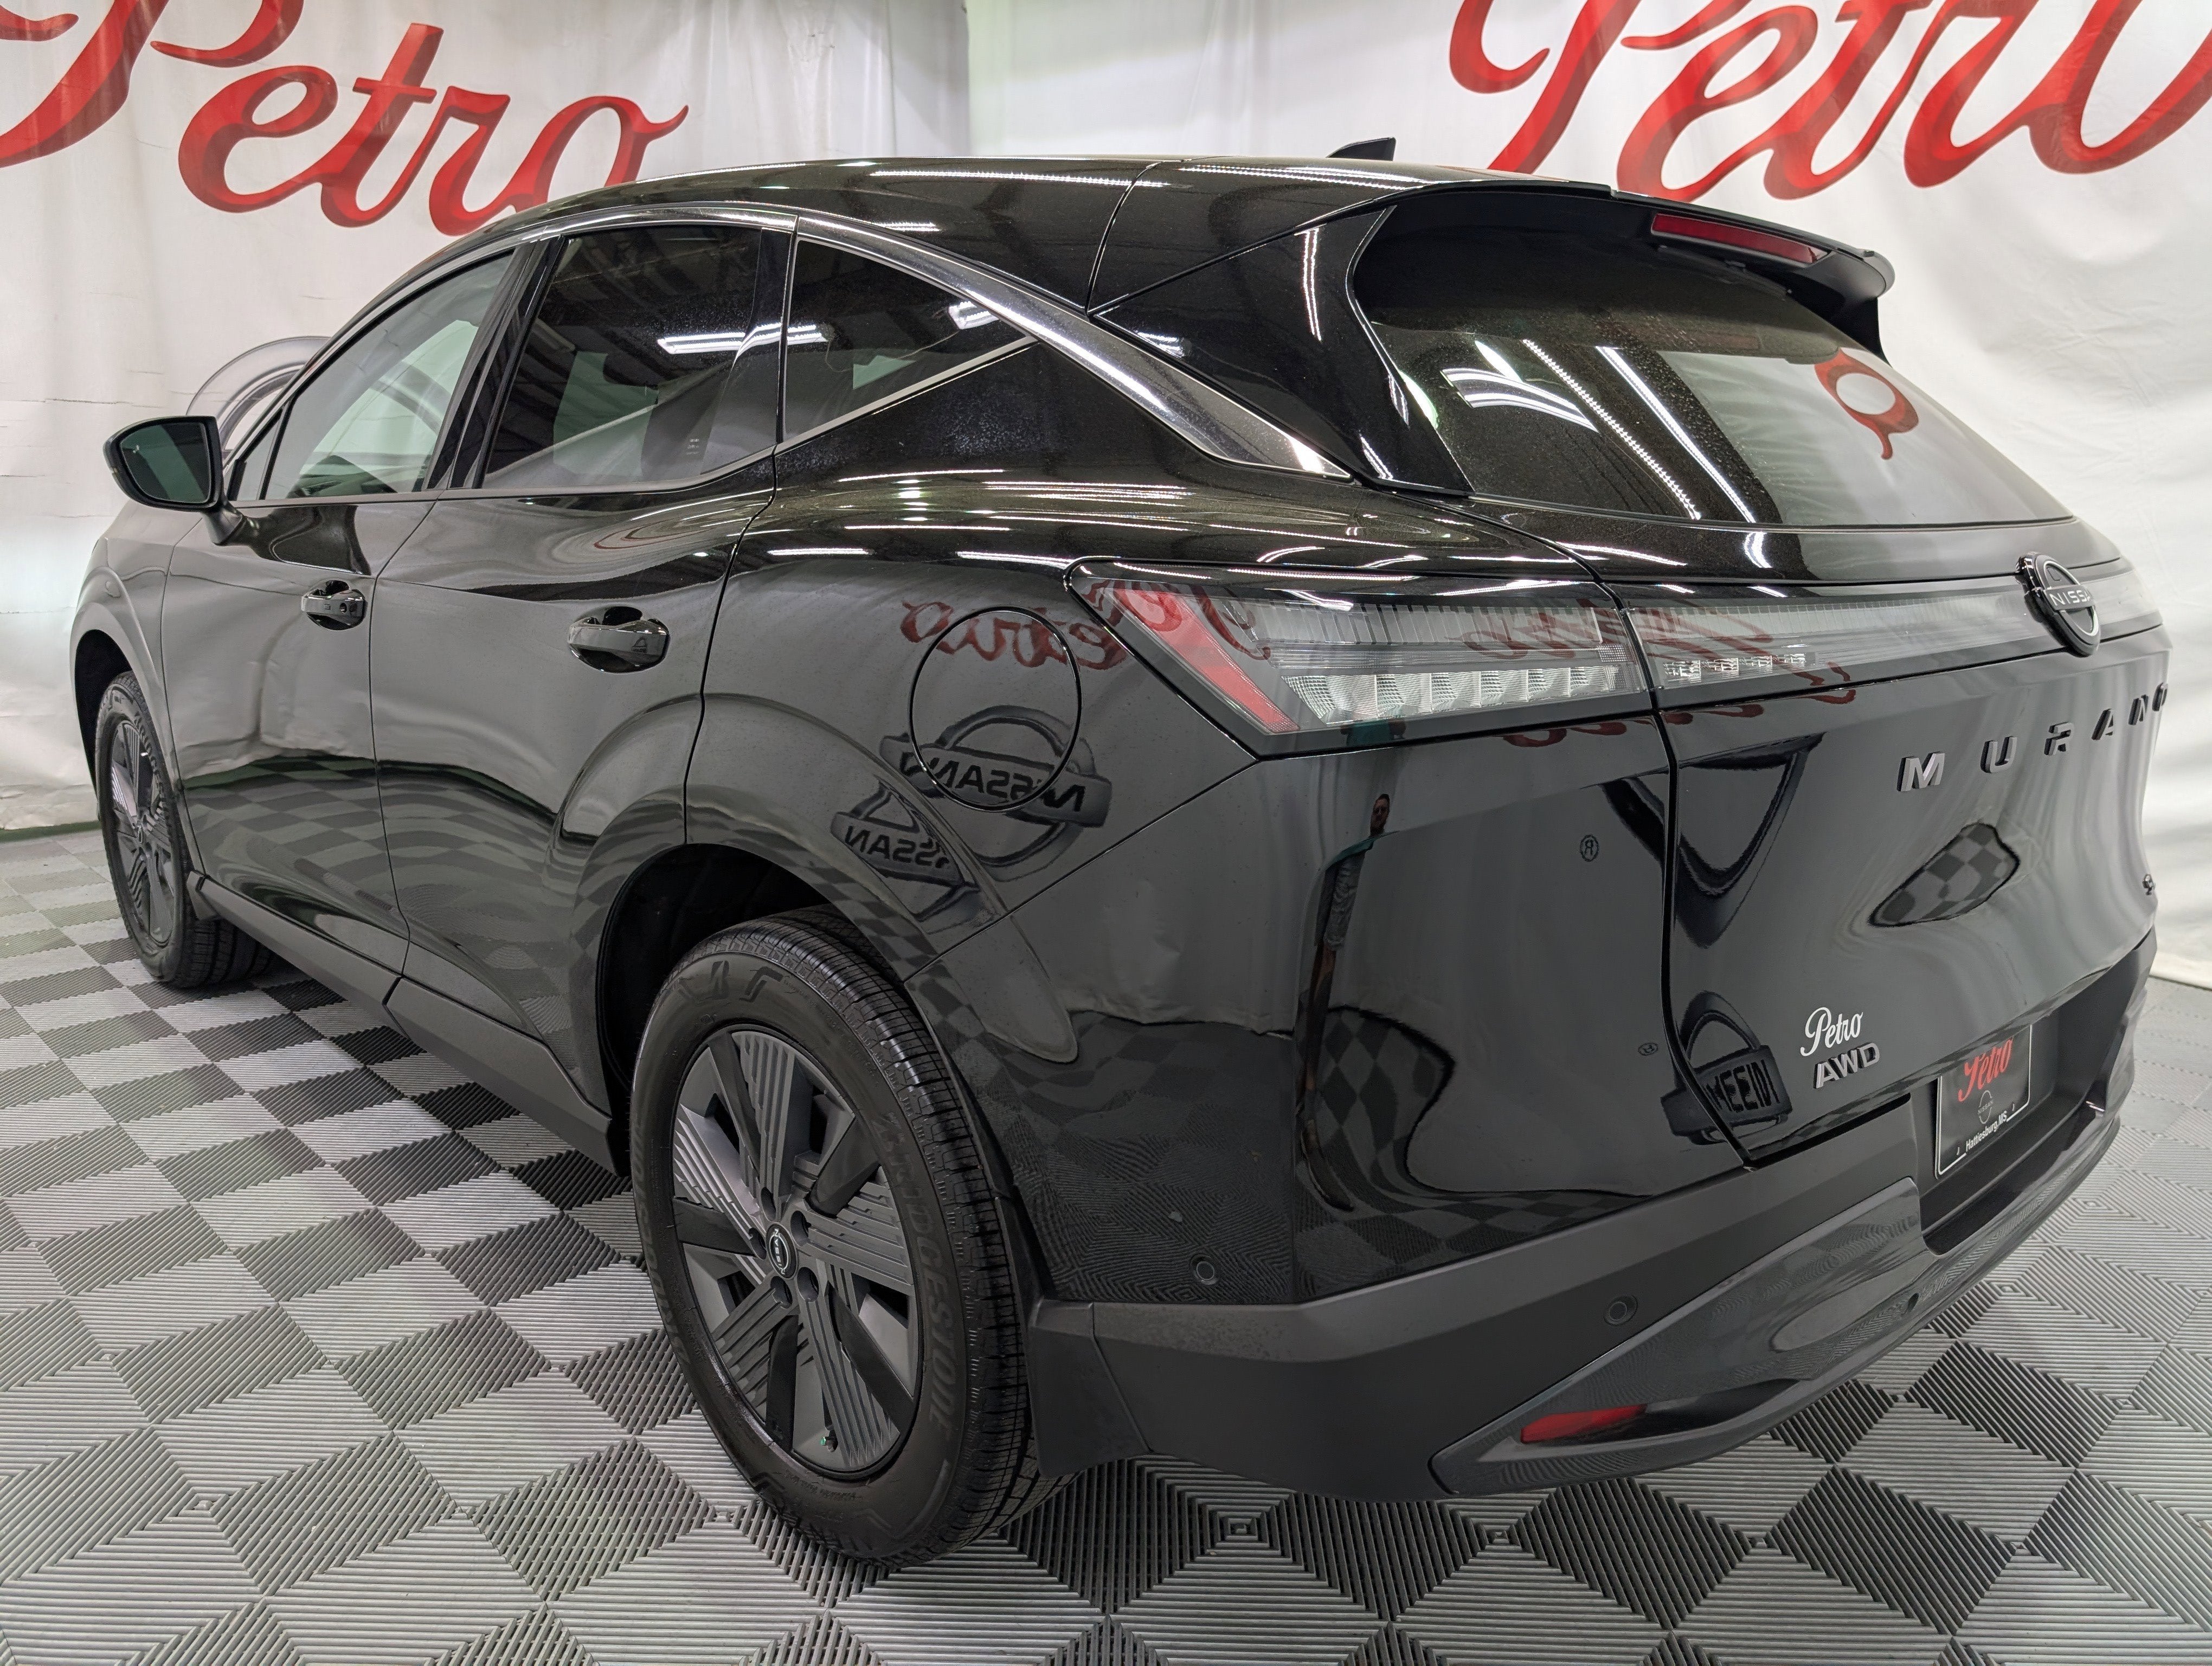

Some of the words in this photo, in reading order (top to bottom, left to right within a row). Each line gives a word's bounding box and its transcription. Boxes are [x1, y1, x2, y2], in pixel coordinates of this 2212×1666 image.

[1897, 682, 2168, 792] MURANO
[1800, 1007, 1863, 1056] Petro
[1813, 1042, 1880, 1089] AWD
[774, 1228, 786, 1275] NISSAN
